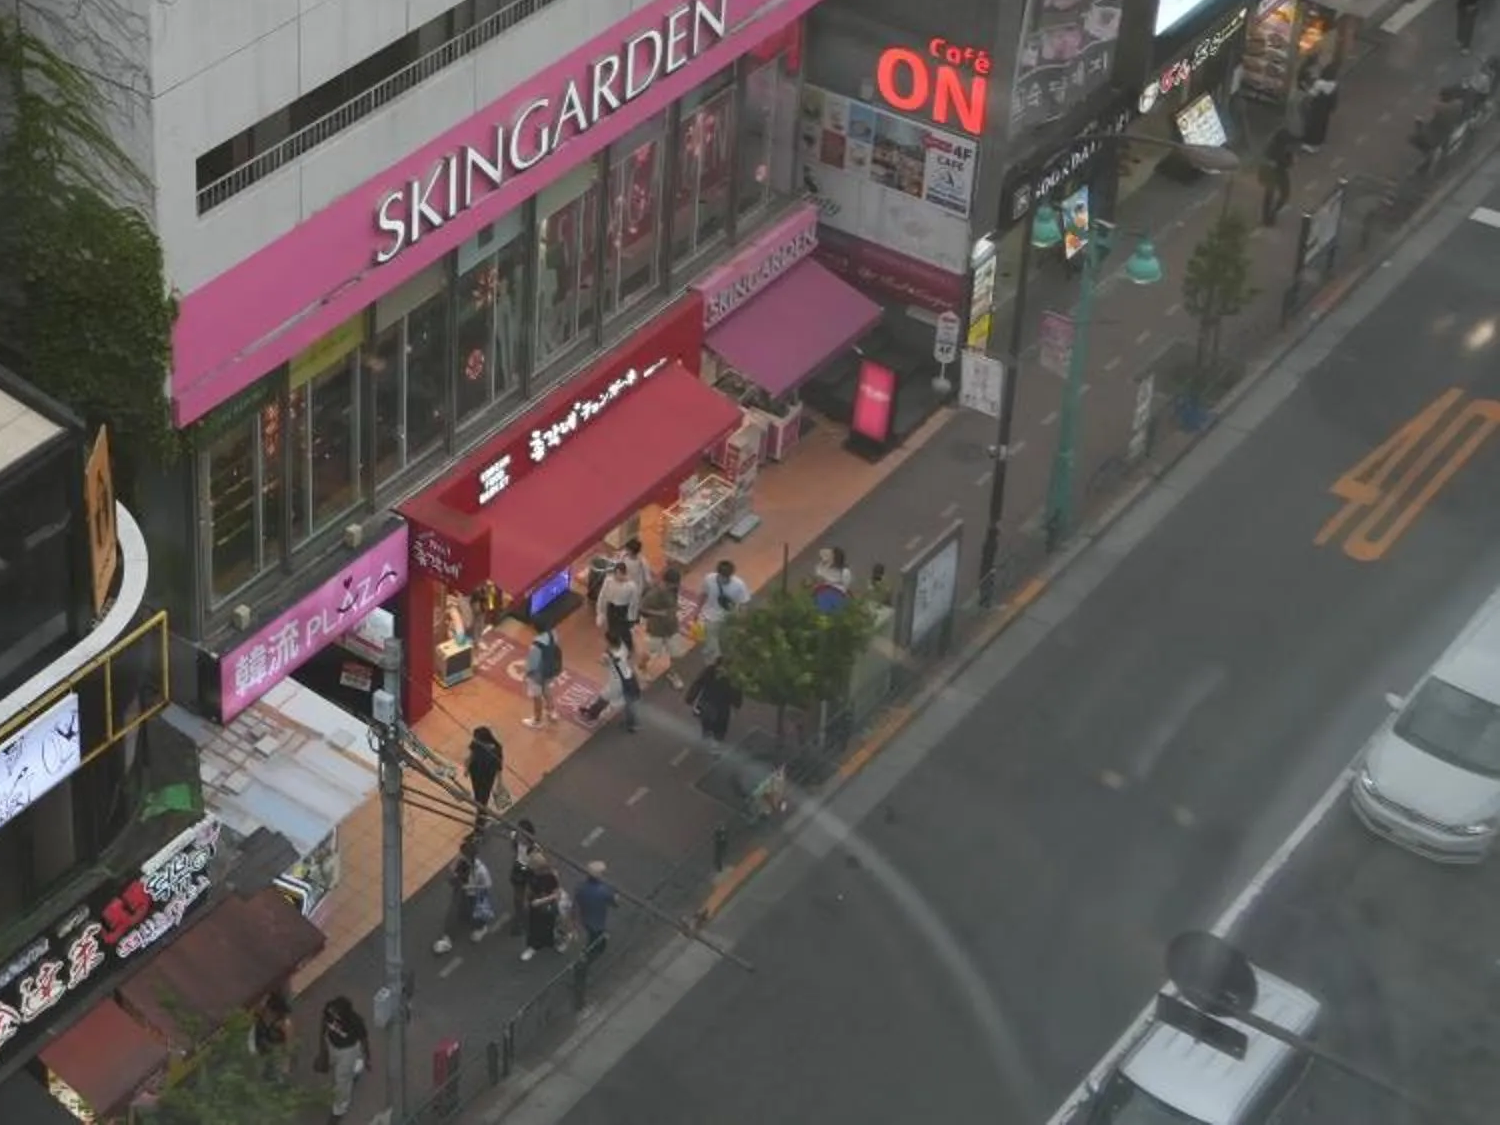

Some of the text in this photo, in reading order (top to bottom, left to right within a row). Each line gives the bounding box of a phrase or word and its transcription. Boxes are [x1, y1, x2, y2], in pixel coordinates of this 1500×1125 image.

[876, 46, 988, 136] ON
[706, 225, 817, 324] SKINGARDEN
[234, 561, 399, 699] 韓流 PLAZA
